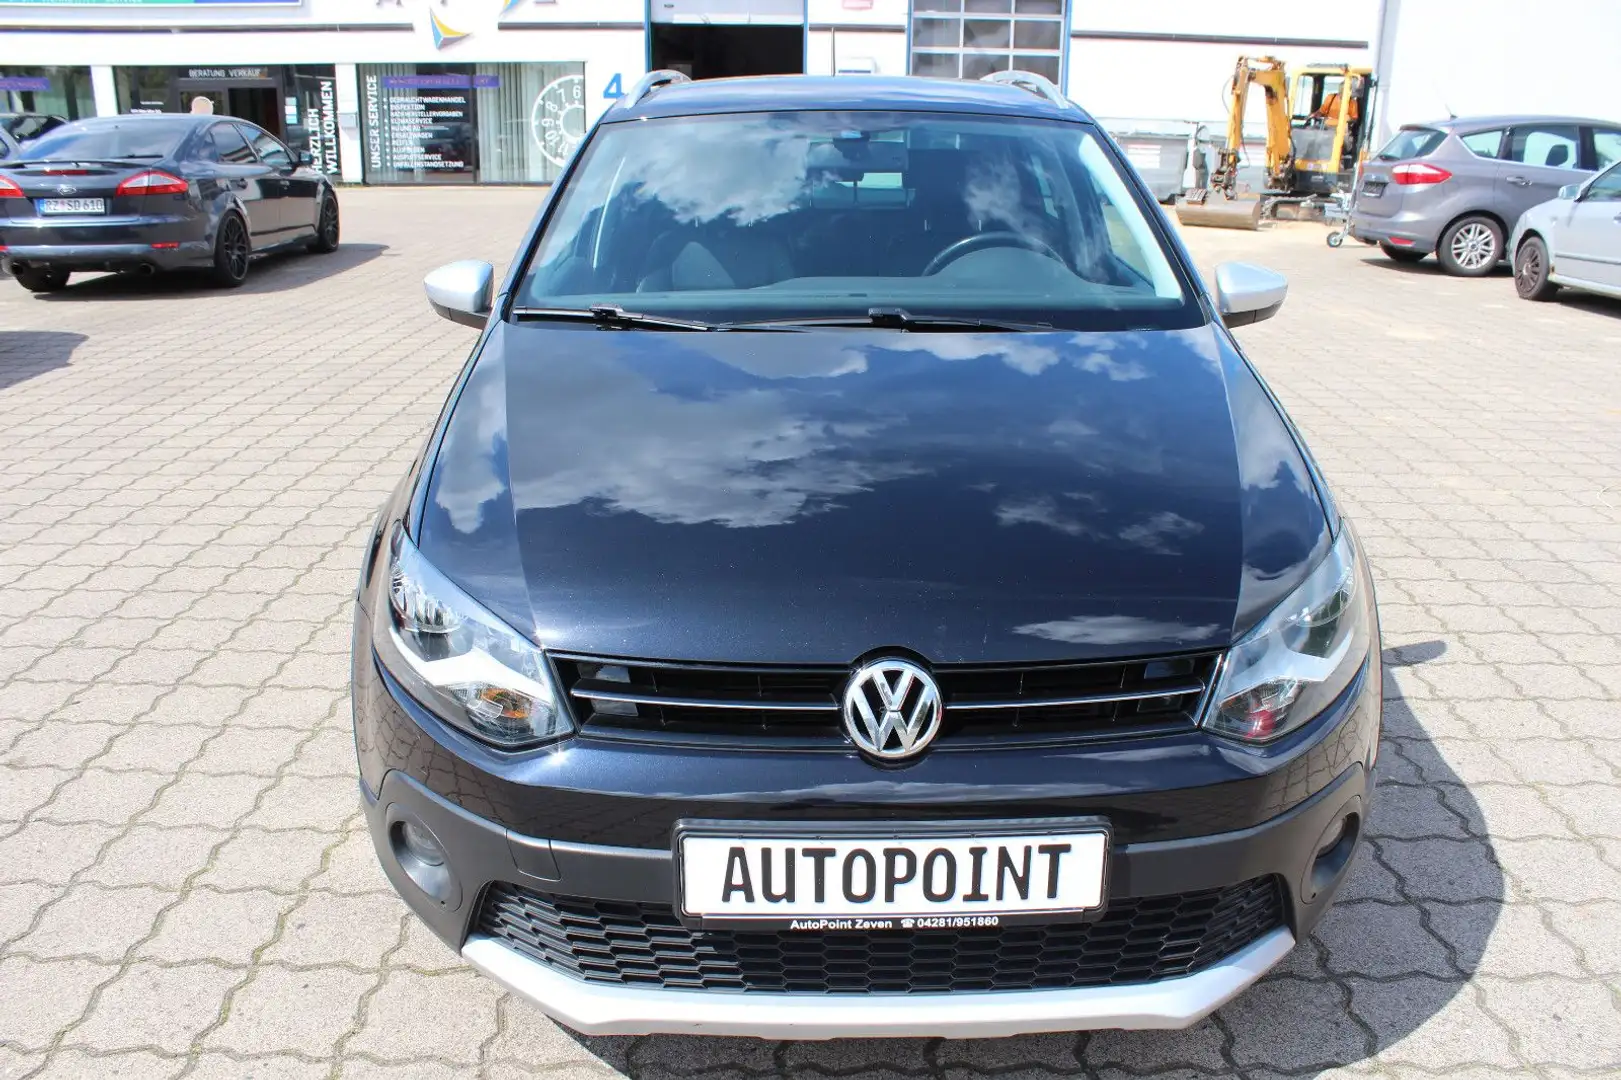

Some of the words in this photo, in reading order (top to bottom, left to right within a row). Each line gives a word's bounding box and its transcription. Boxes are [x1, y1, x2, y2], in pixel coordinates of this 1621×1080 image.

[366, 75, 379, 126] SERVICE
[603, 73, 625, 99] 4
[307, 108, 323, 174] HERZLICH
[320, 81, 338, 174] WILLKOMMEN
[368, 127, 382, 168] UNSER
[721, 843, 1072, 904] AUTOPOINT
[790, 918, 852, 931] AutoPoint
[855, 919, 893, 930] Zeven
[917, 916, 999, 928] 04281/951860
